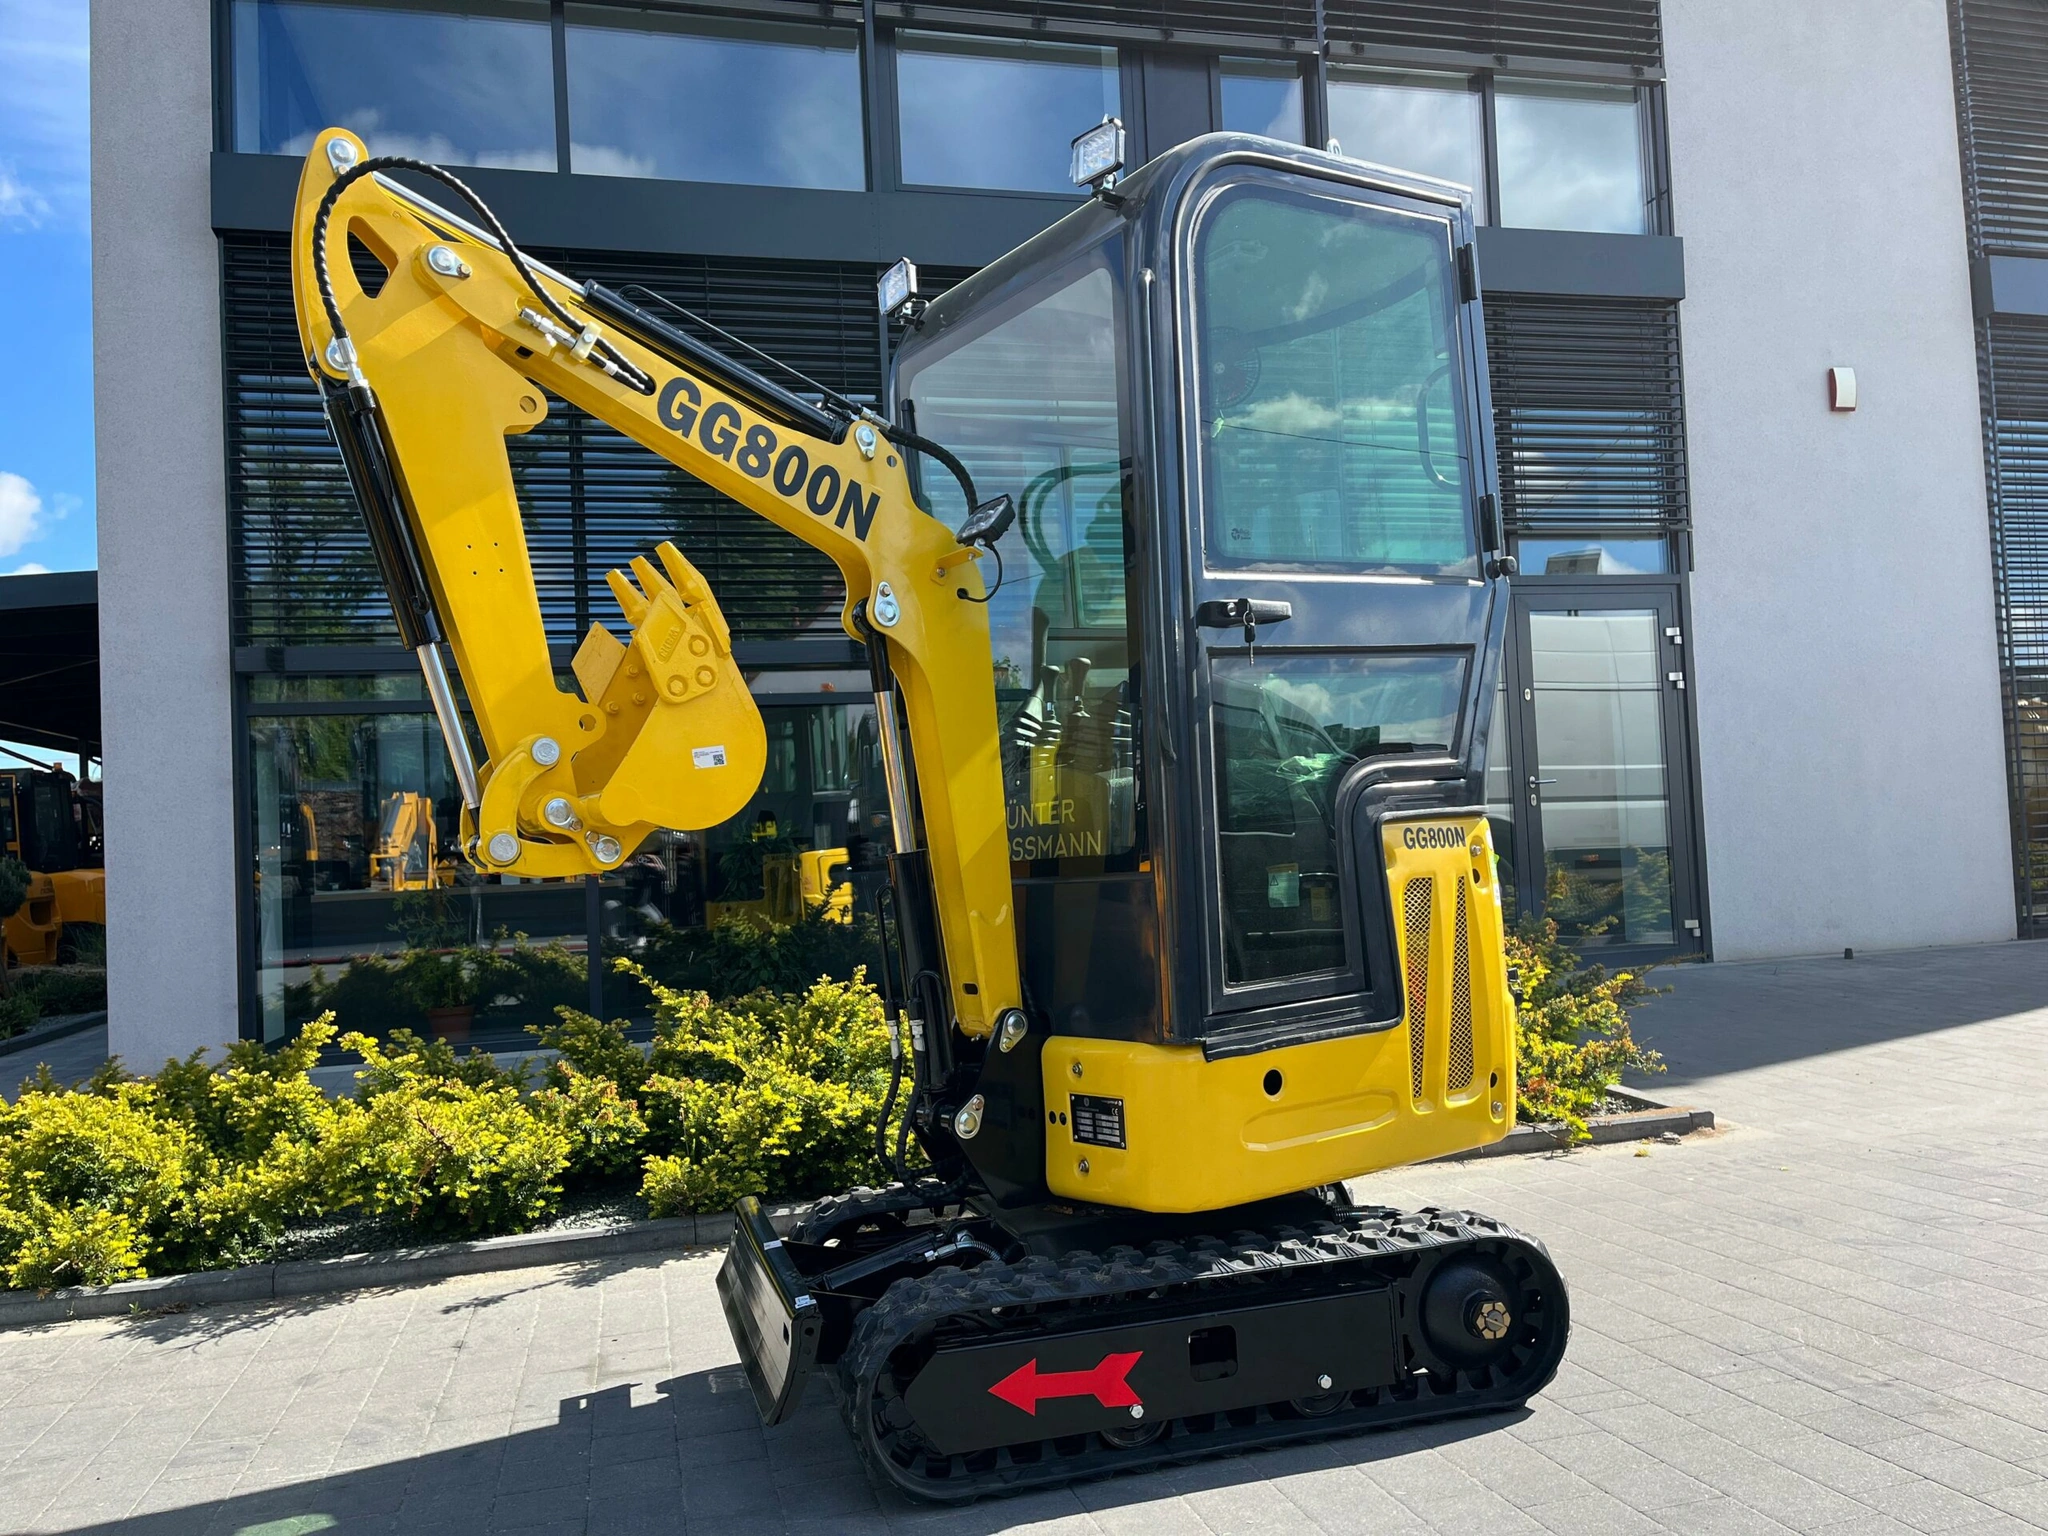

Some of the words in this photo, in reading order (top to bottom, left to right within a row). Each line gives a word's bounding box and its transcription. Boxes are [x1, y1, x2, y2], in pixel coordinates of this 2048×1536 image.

[657, 377, 881, 542] GG800N
[1008, 830, 1101, 861] SSMANN
[1403, 827, 1466, 850] GG800N
